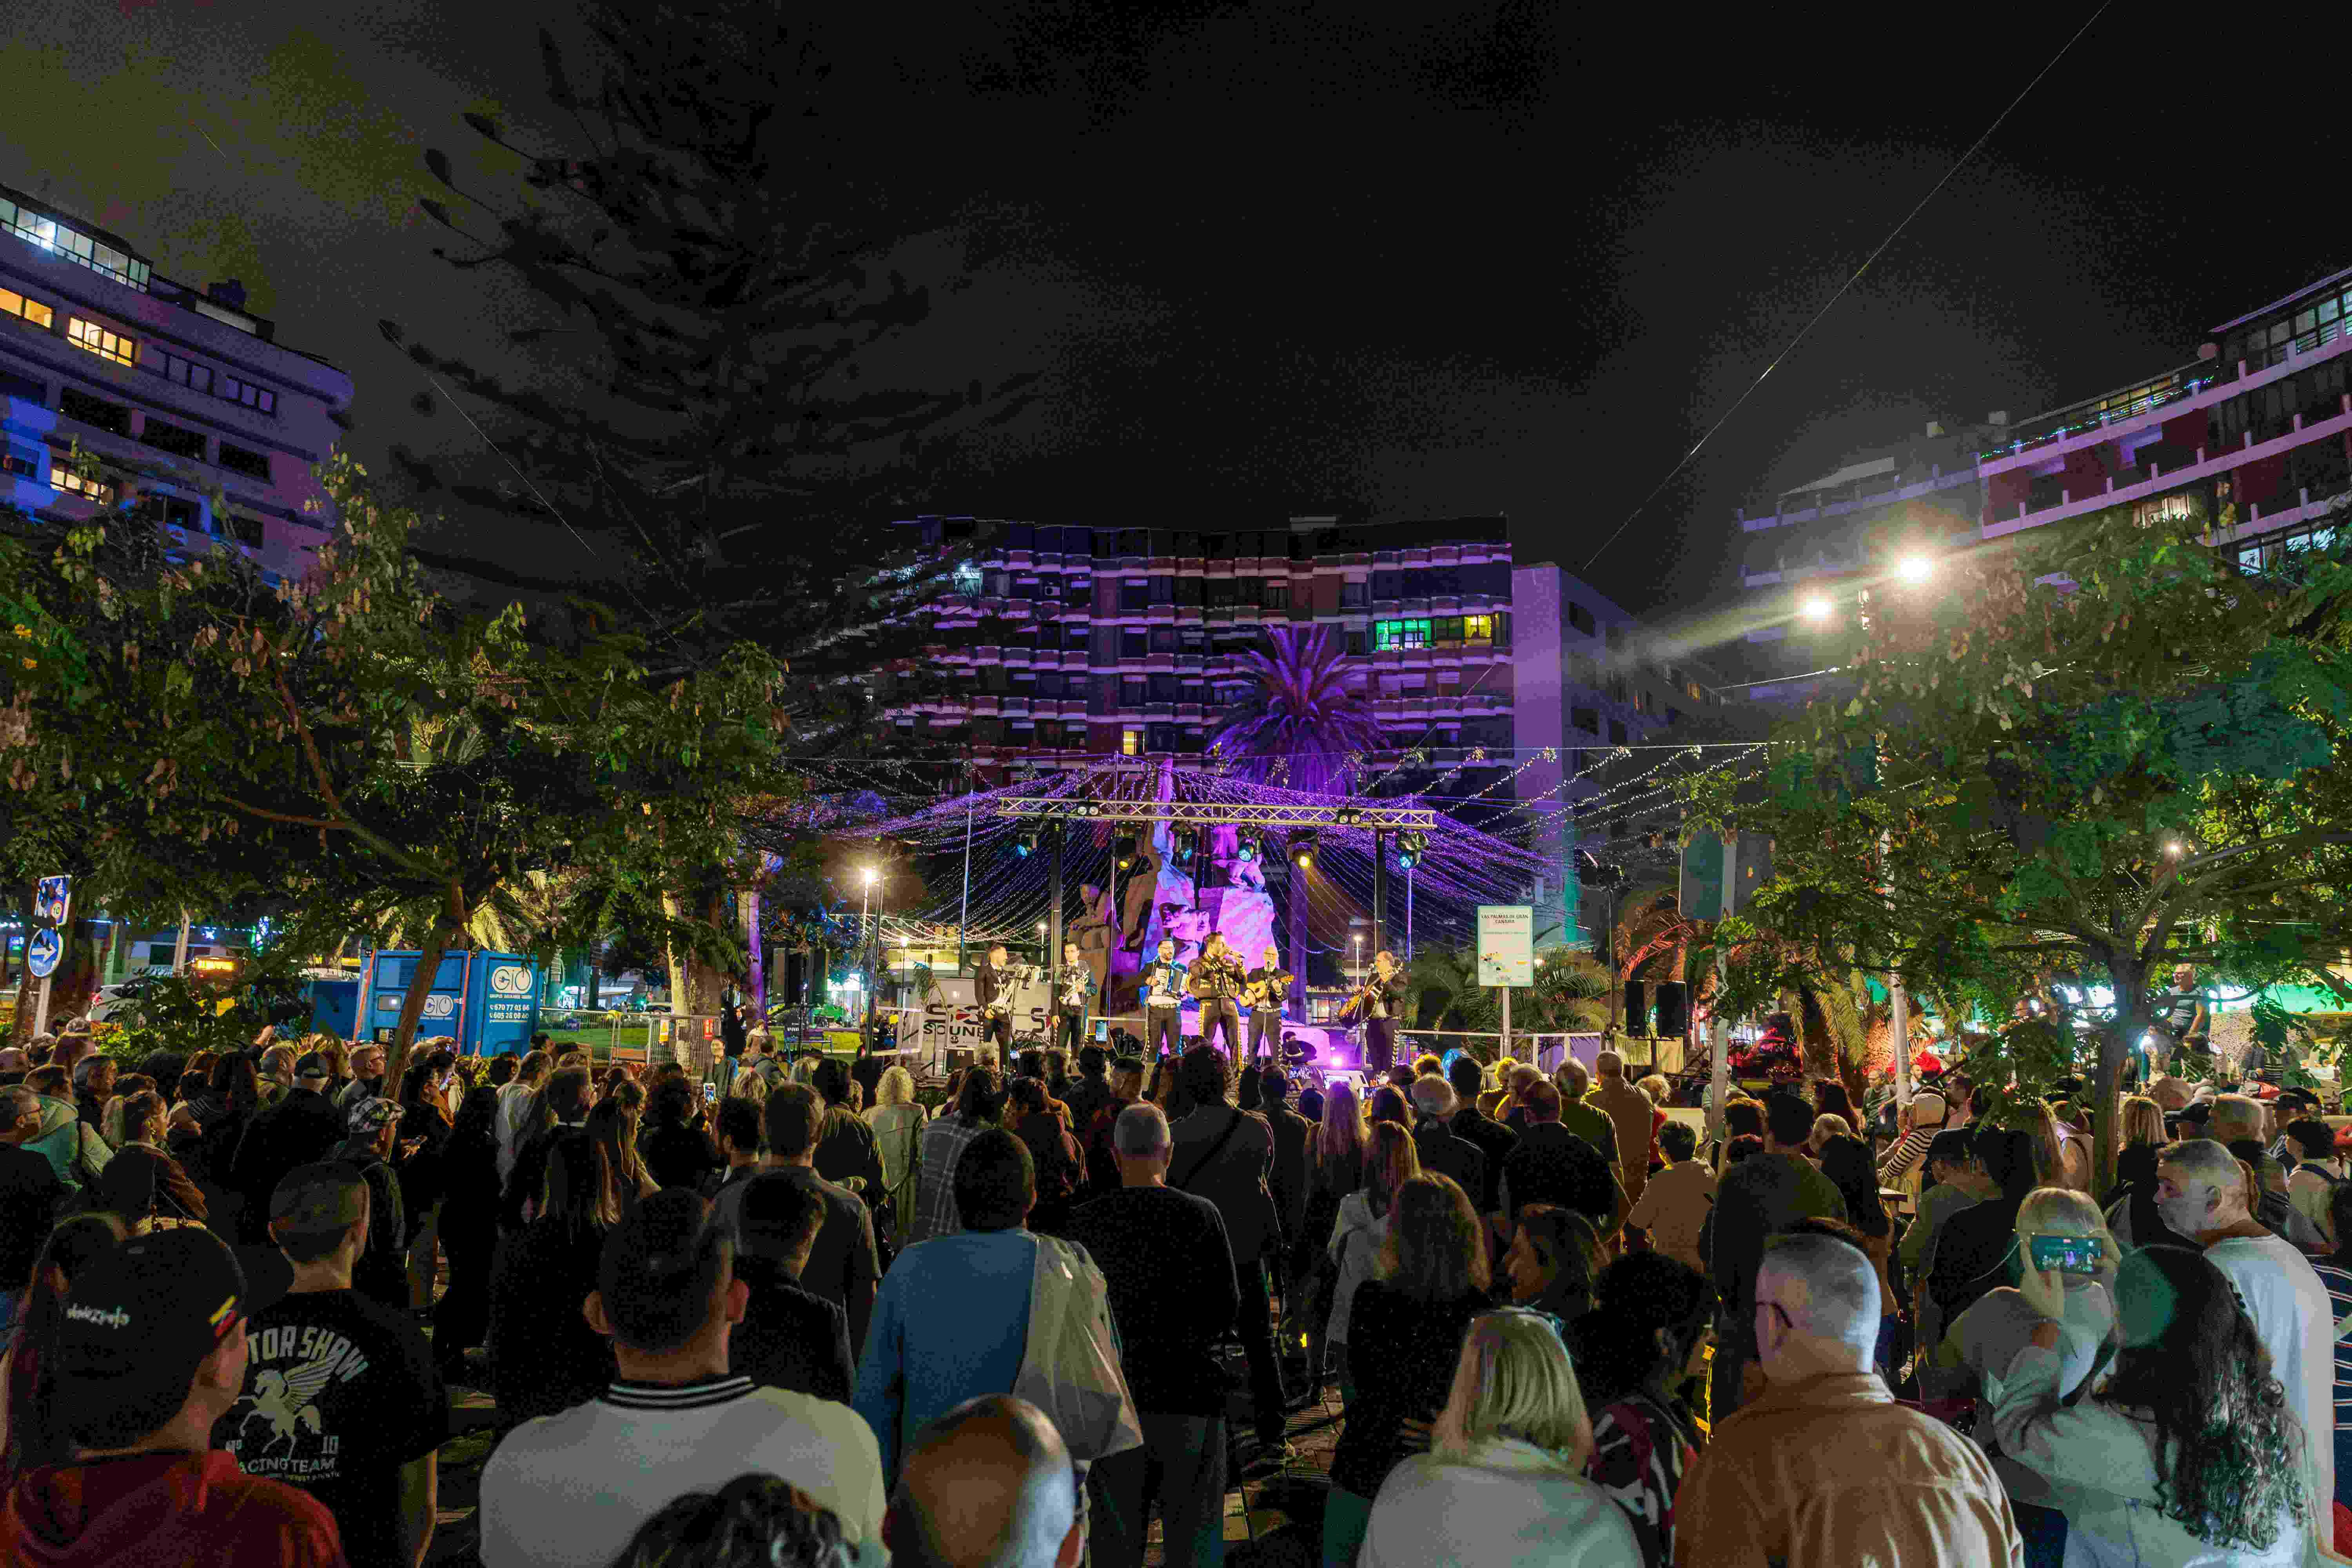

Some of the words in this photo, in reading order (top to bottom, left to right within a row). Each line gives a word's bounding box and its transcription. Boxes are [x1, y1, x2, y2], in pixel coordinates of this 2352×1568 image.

[248, 1325, 297, 1364] TOR
[238, 1458, 288, 1474] ACING
[290, 1457, 336, 1473] TEAM
